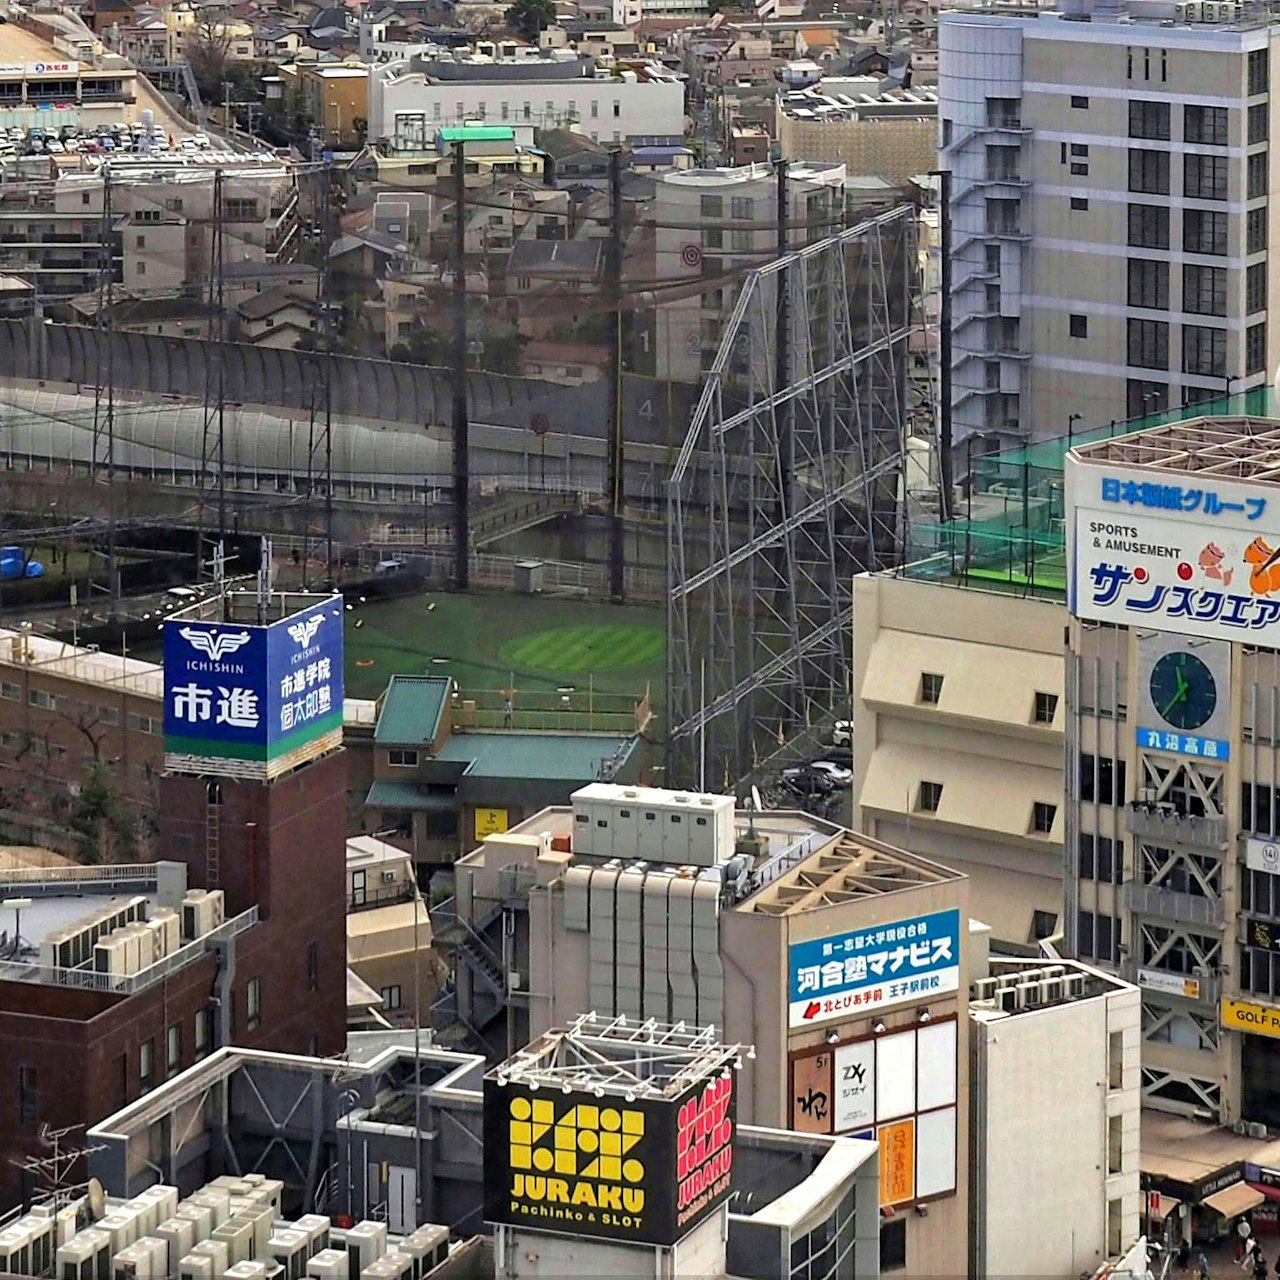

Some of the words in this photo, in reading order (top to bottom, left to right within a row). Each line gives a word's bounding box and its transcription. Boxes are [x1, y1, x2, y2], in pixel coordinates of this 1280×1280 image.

[640, 330, 650, 352] 1
[638, 400, 654, 420] 4
[1102, 477, 1267, 520] 日本製紙グループ
[1090, 522, 1138, 538] SPORTS
[1093, 538, 1102, 548] &
[1105, 539, 1181, 559] AMUSEMENT
[291, 644, 320, 665] ICHISHIN
[186, 660, 244, 674] ICHISHIN
[281, 657, 331, 698] 市進学院
[171, 683, 260, 728] 市進
[1148, 730, 1218, 757] 丸沼高原
[1265, 849, 1276, 859] 141
[823, 922, 927, 956] 第一志望大学現役合格
[797, 937, 953, 993] 河合塾マナビス
[889, 975, 940, 998] 王子駅前校
[824, 988, 883, 1013] 北とぴあ手前
[1236, 1010, 1268, 1024] GOLF
[843, 1063, 866, 1084] ZXY
[677, 1143, 732, 1210] JURAKU
[510, 1174, 645, 1213] JURAKU
[511, 1201, 583, 1221] Pachinko
[588, 1212, 596, 1222] &
[602, 1214, 642, 1229] SLOT
